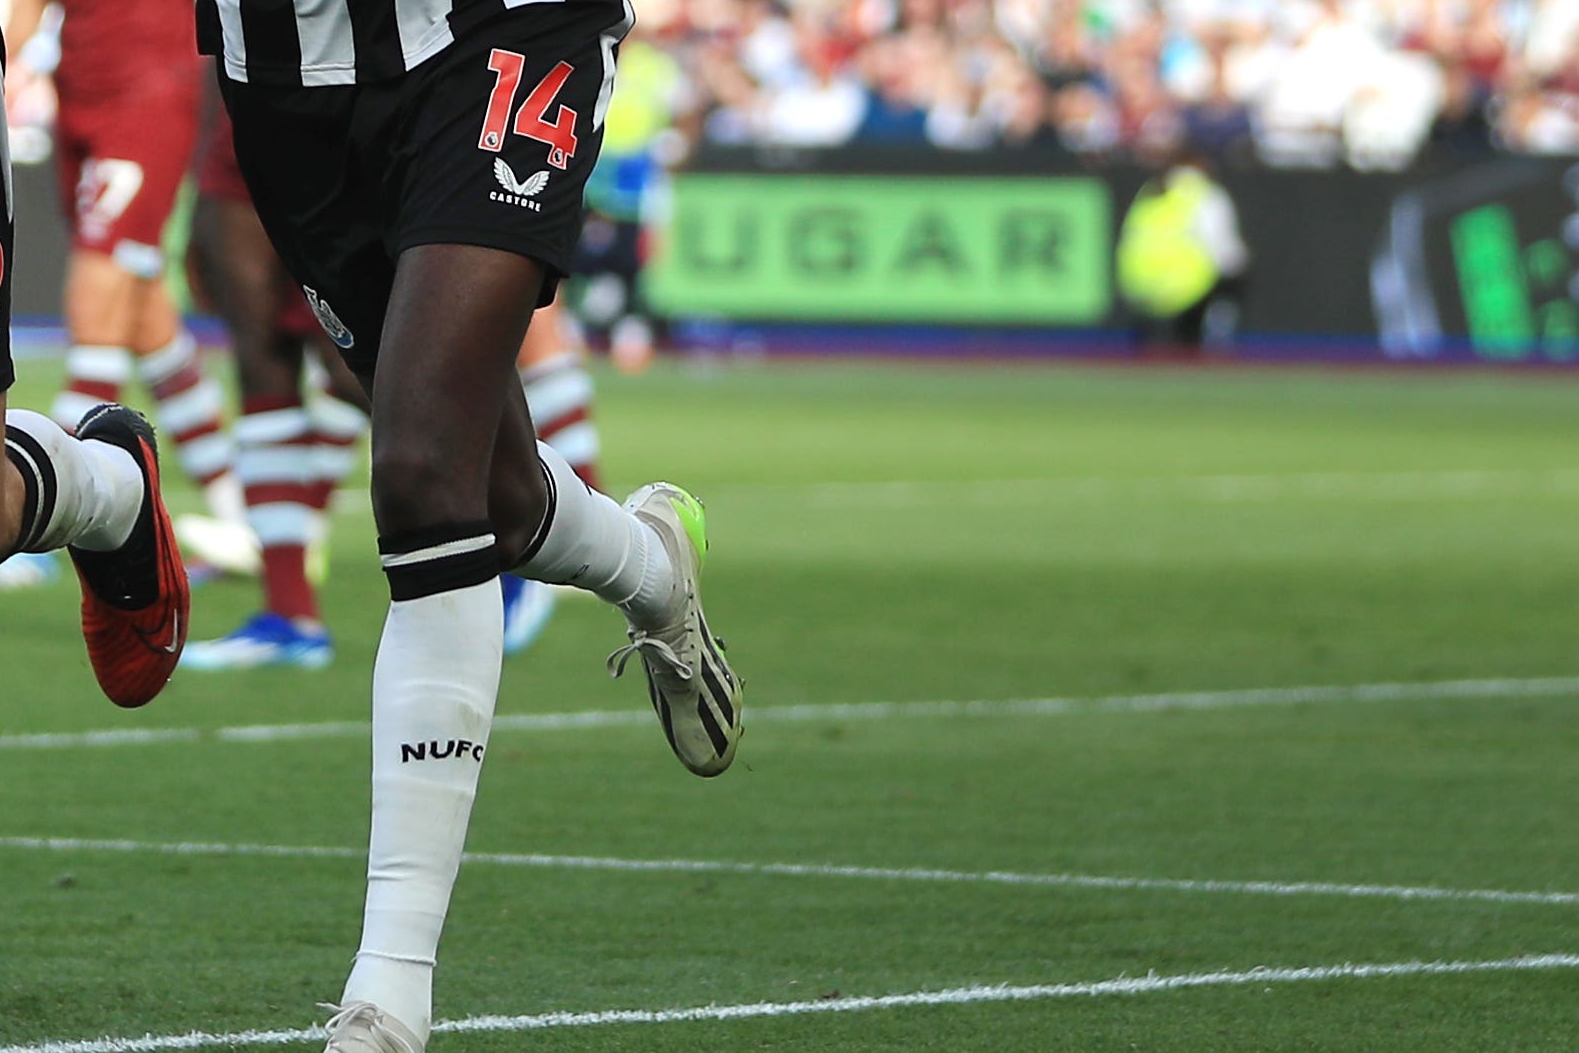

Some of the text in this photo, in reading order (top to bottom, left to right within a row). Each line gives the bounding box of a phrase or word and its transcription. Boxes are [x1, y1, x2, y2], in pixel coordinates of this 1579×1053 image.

[477, 48, 578, 170] 14
[489, 190, 541, 213] CASTORE
[400, 739, 484, 764] NUFC
